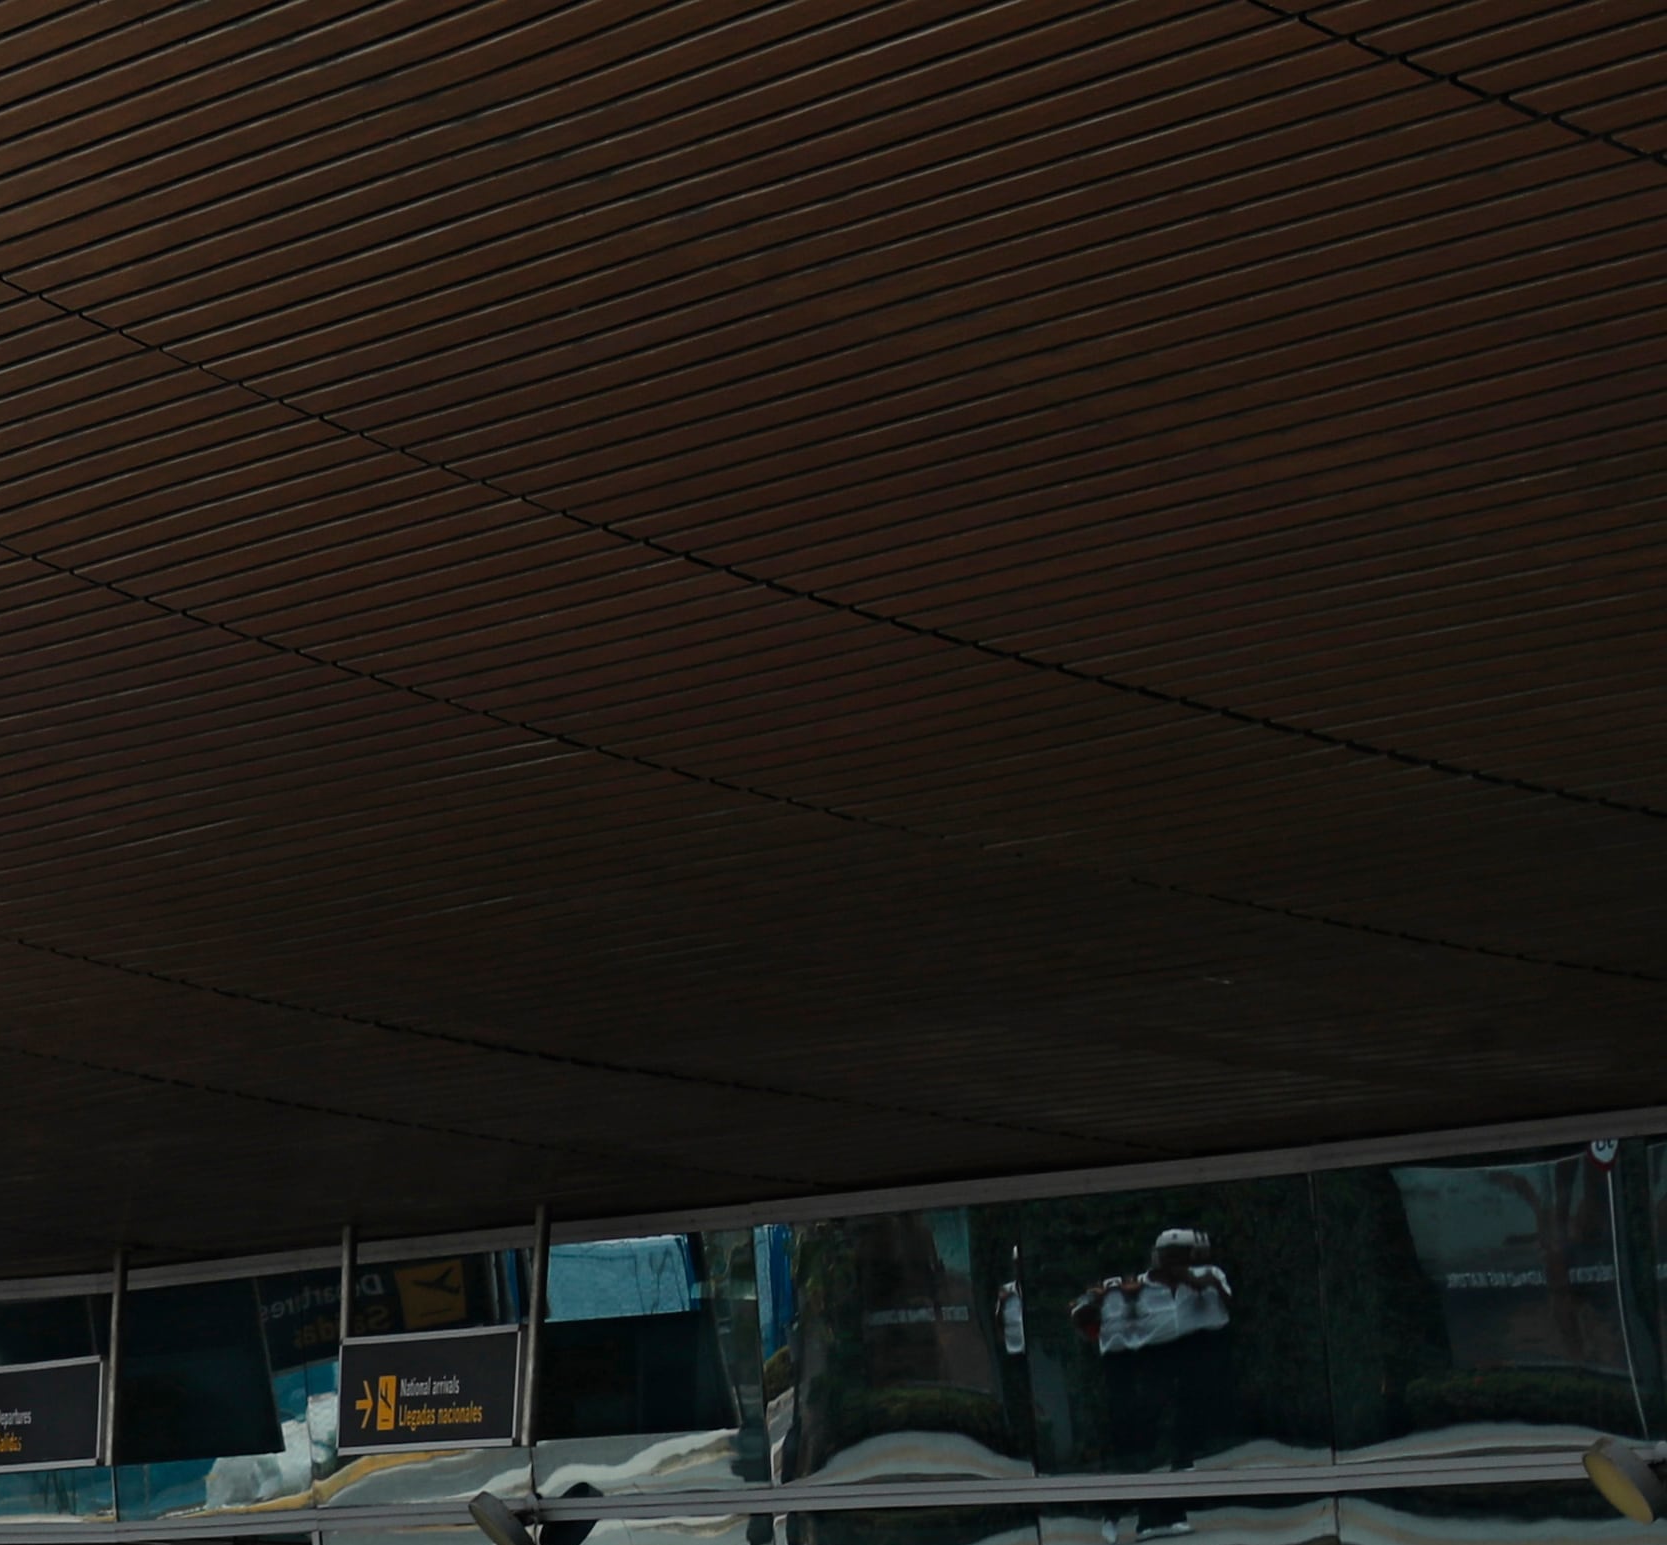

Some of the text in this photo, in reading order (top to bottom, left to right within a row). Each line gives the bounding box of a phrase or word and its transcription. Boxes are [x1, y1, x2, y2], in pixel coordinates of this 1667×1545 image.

[399, 1374, 460, 1397] National arrivals
[399, 1400, 483, 1432] Llegadas nacionales
